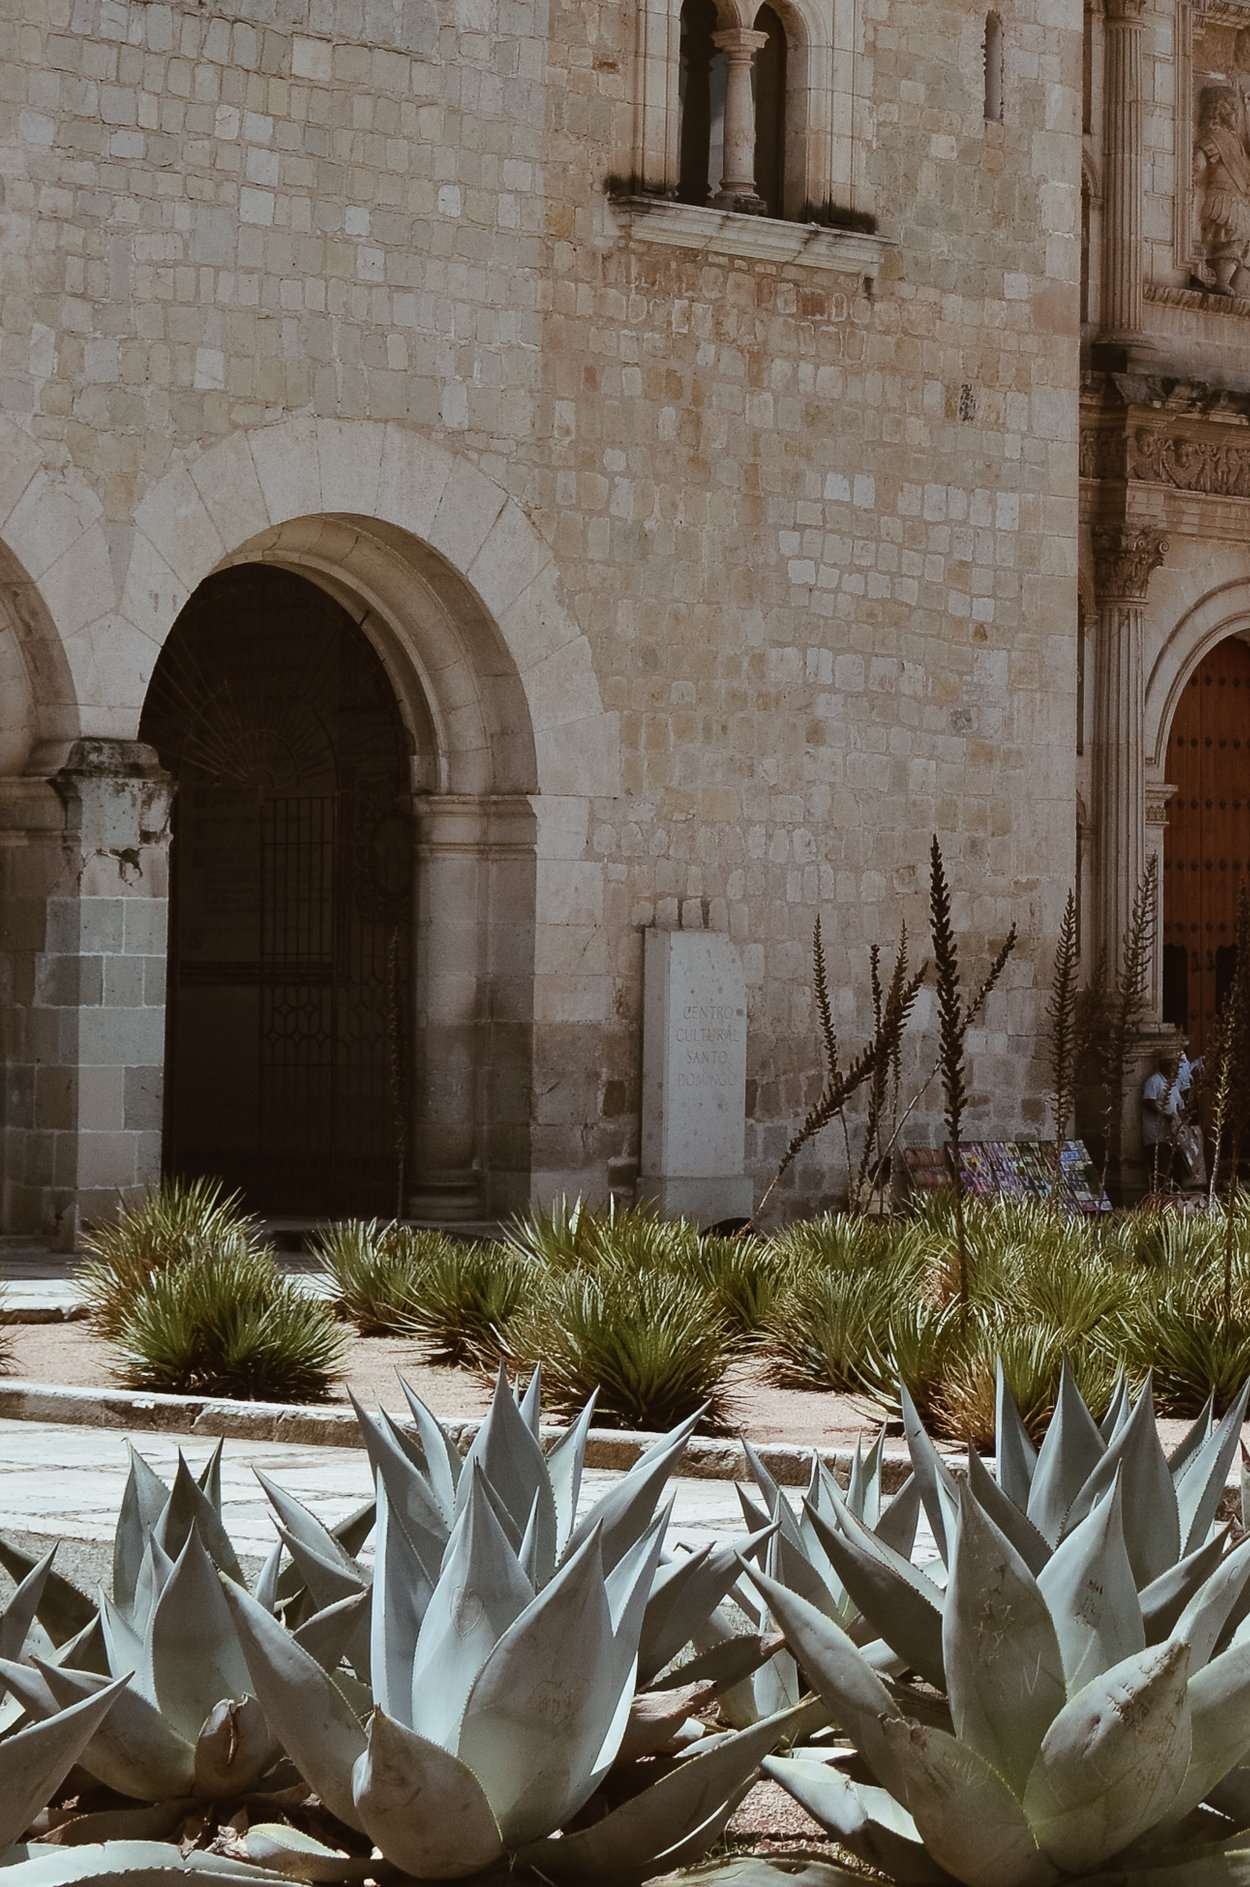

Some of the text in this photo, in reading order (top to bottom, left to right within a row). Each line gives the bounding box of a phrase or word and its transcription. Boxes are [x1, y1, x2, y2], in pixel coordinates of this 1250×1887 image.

[683, 1006, 733, 1020] CENTRO
[676, 1028, 739, 1042] CULTURAL
[687, 1050, 728, 1064] SANTO
[677, 1072, 736, 1087] DOMINGO
